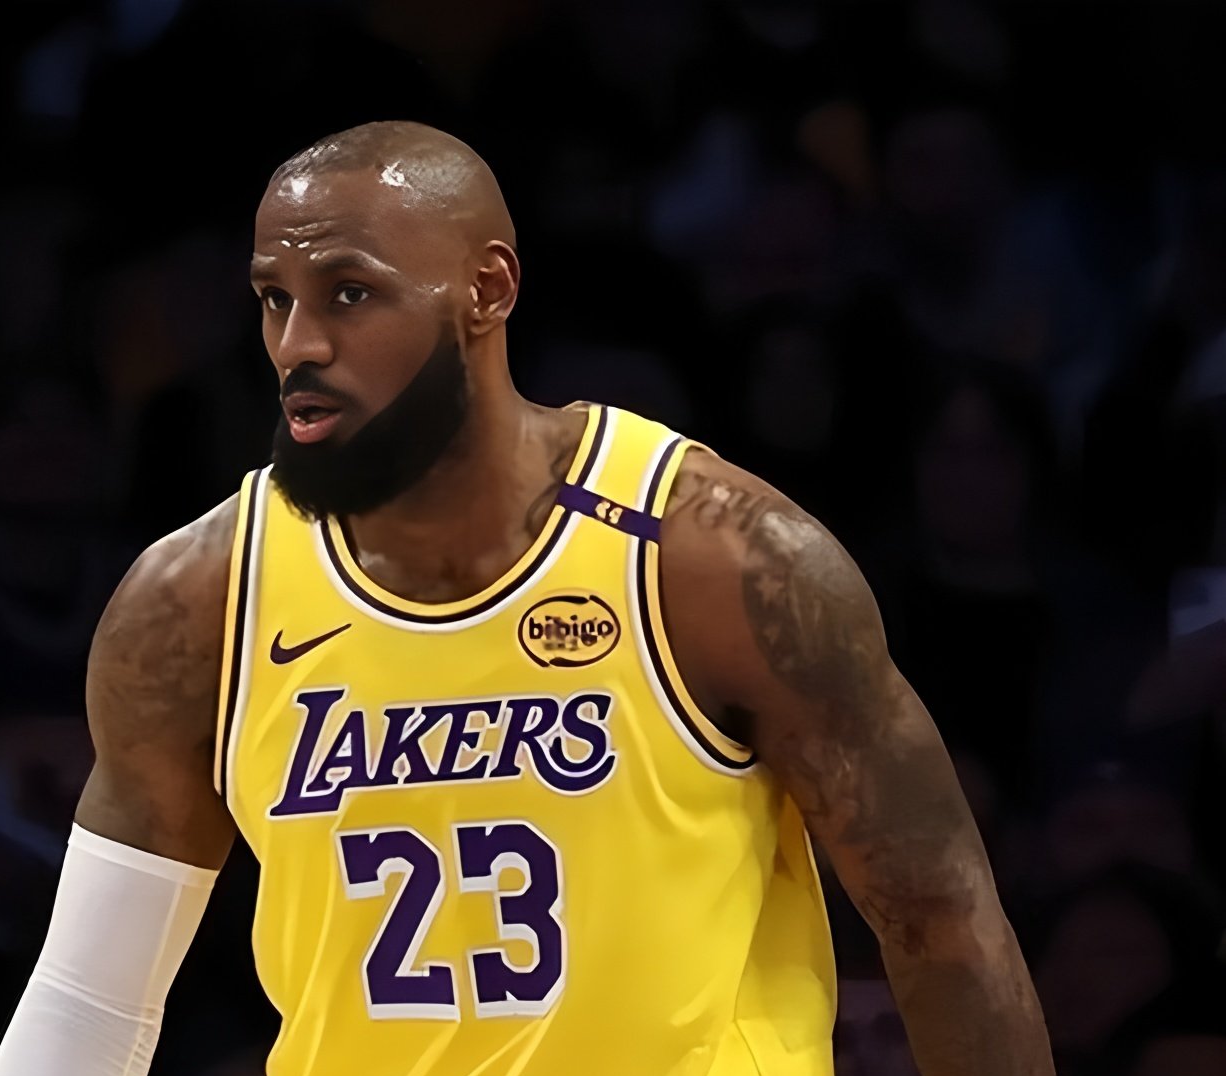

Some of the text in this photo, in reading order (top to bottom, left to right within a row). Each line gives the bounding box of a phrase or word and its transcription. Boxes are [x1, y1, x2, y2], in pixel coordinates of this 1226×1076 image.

[528, 614, 614, 647] bibigo
[267, 685, 617, 817] LAKERS
[336, 821, 568, 1021] 23
